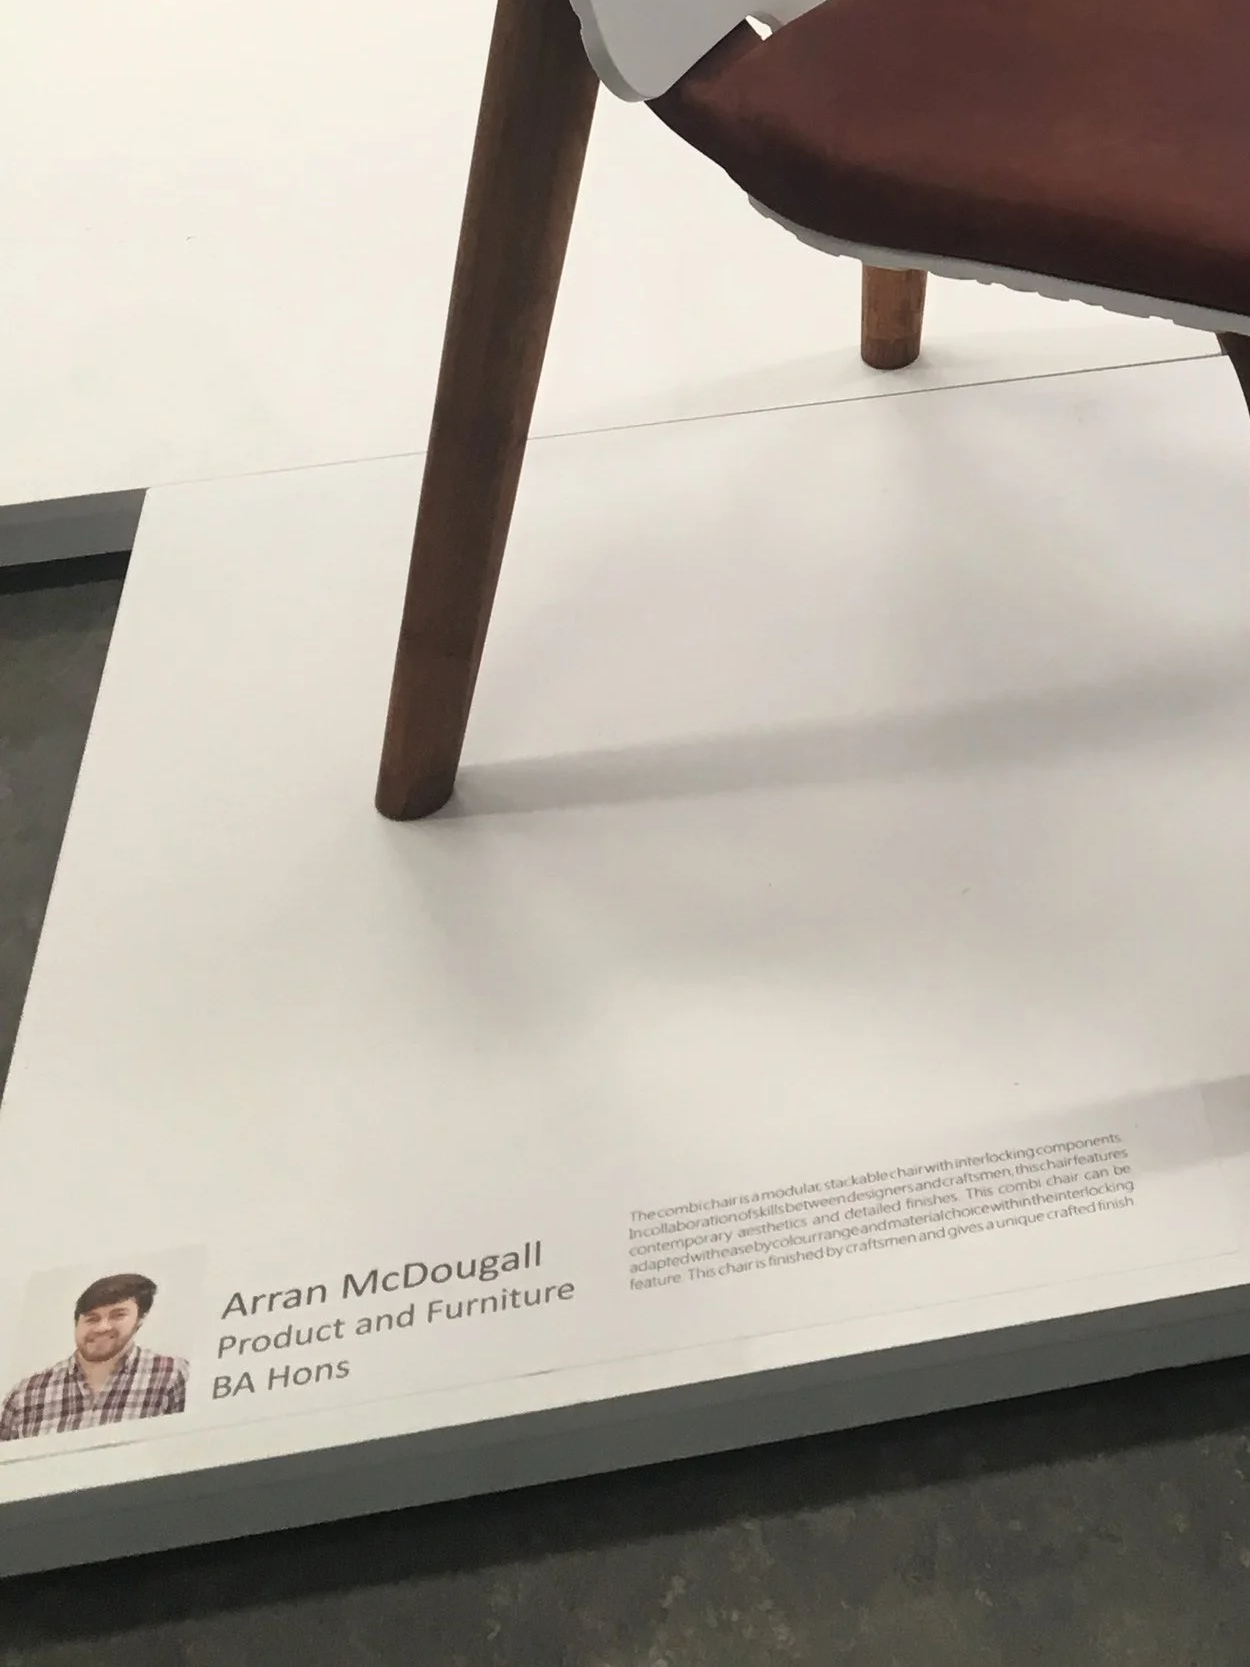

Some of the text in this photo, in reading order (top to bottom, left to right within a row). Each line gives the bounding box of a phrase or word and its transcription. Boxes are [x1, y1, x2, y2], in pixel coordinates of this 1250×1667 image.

[221, 1241, 541, 1319] Arran McDougall
[218, 1283, 574, 1358] Product and Furniture
[212, 1360, 350, 1399] BA Hons
